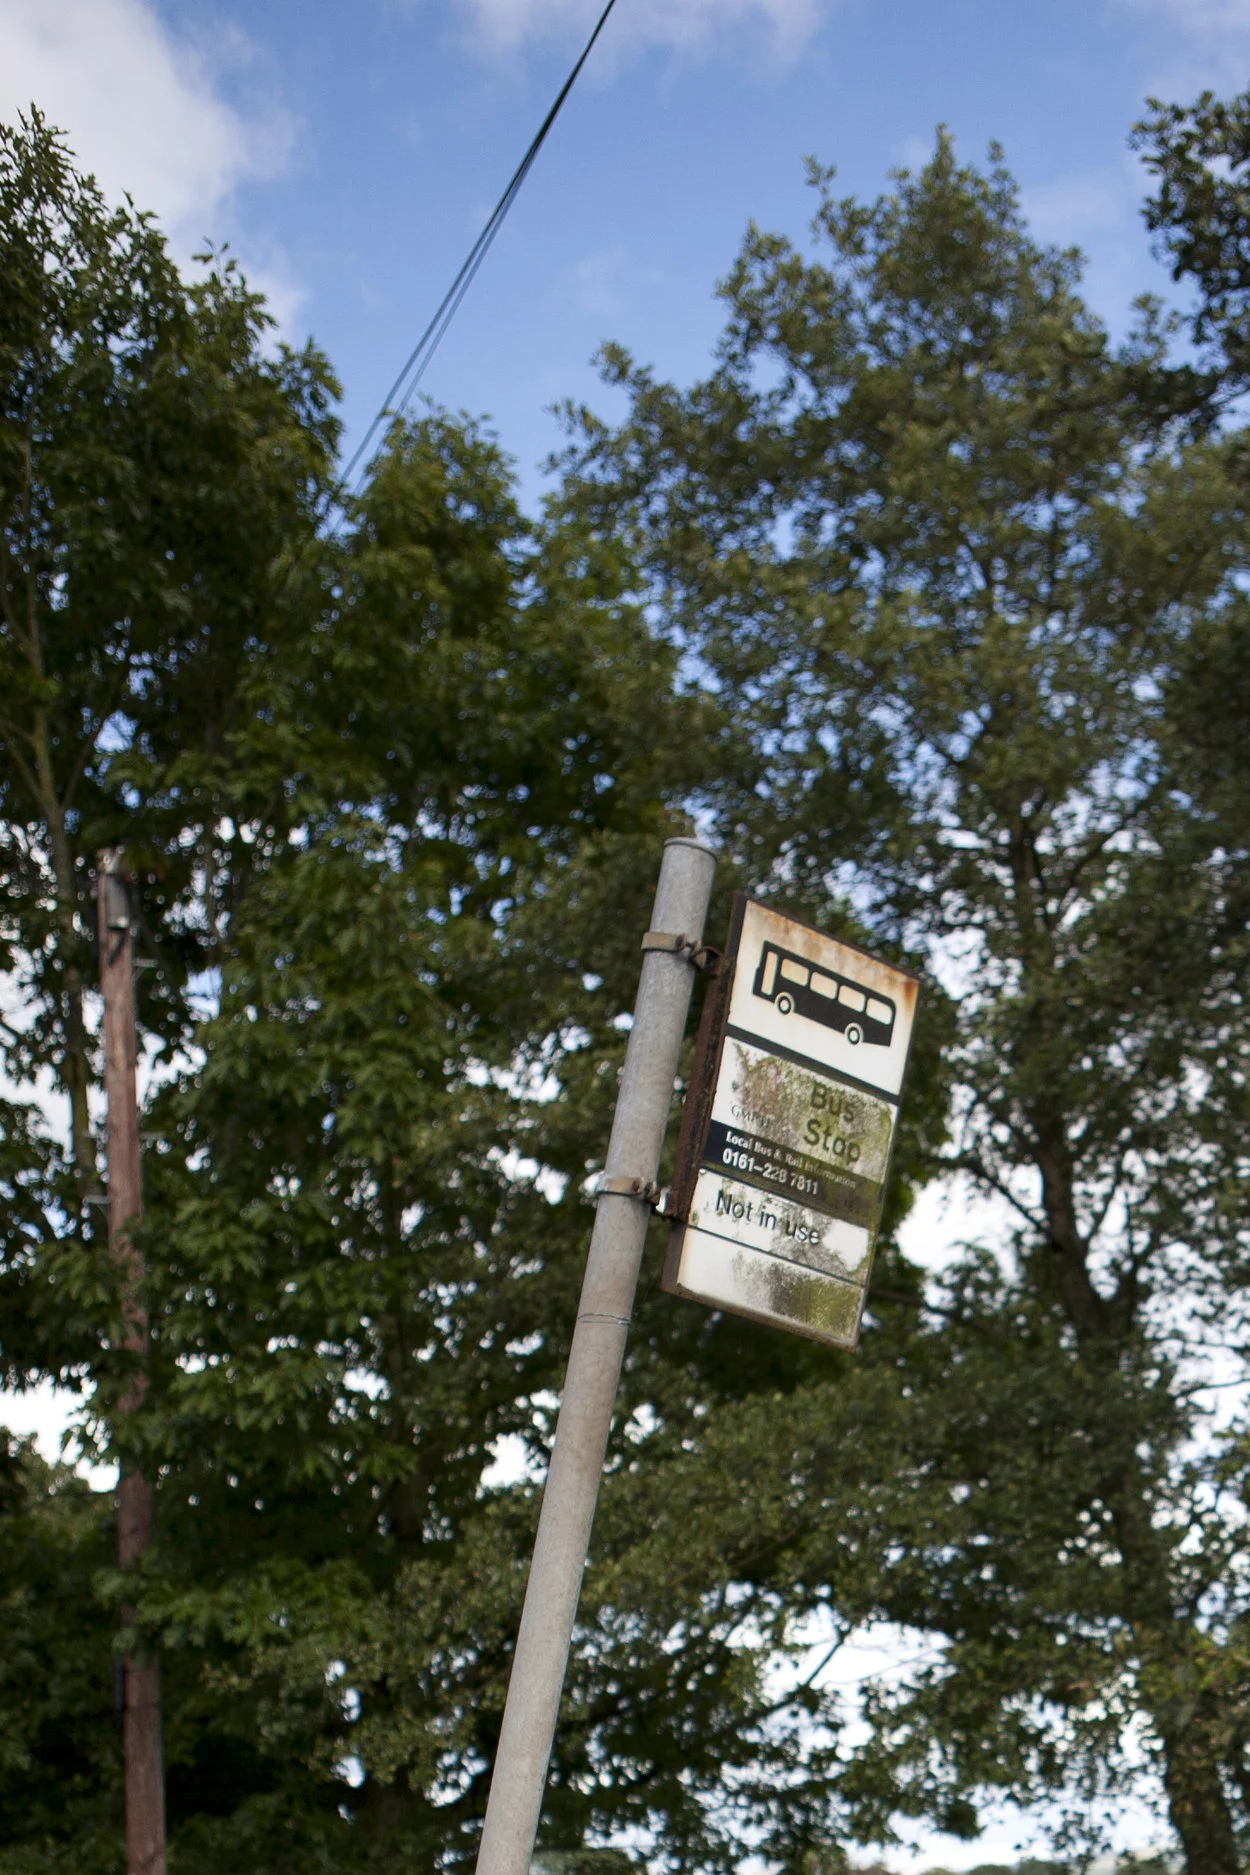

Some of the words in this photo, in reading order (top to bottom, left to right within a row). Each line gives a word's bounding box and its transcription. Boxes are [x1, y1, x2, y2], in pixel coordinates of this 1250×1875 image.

[811, 1081, 855, 1122] Bus
[726, 1131, 753, 1150] Local
[754, 1141, 772, 1157] Bus
[803, 1119, 861, 1166] Stop
[790, 1172, 818, 1195] 7811
[716, 1189, 754, 1222] Not
[759, 1205, 777, 1230] in
[785, 1219, 820, 1246] use
